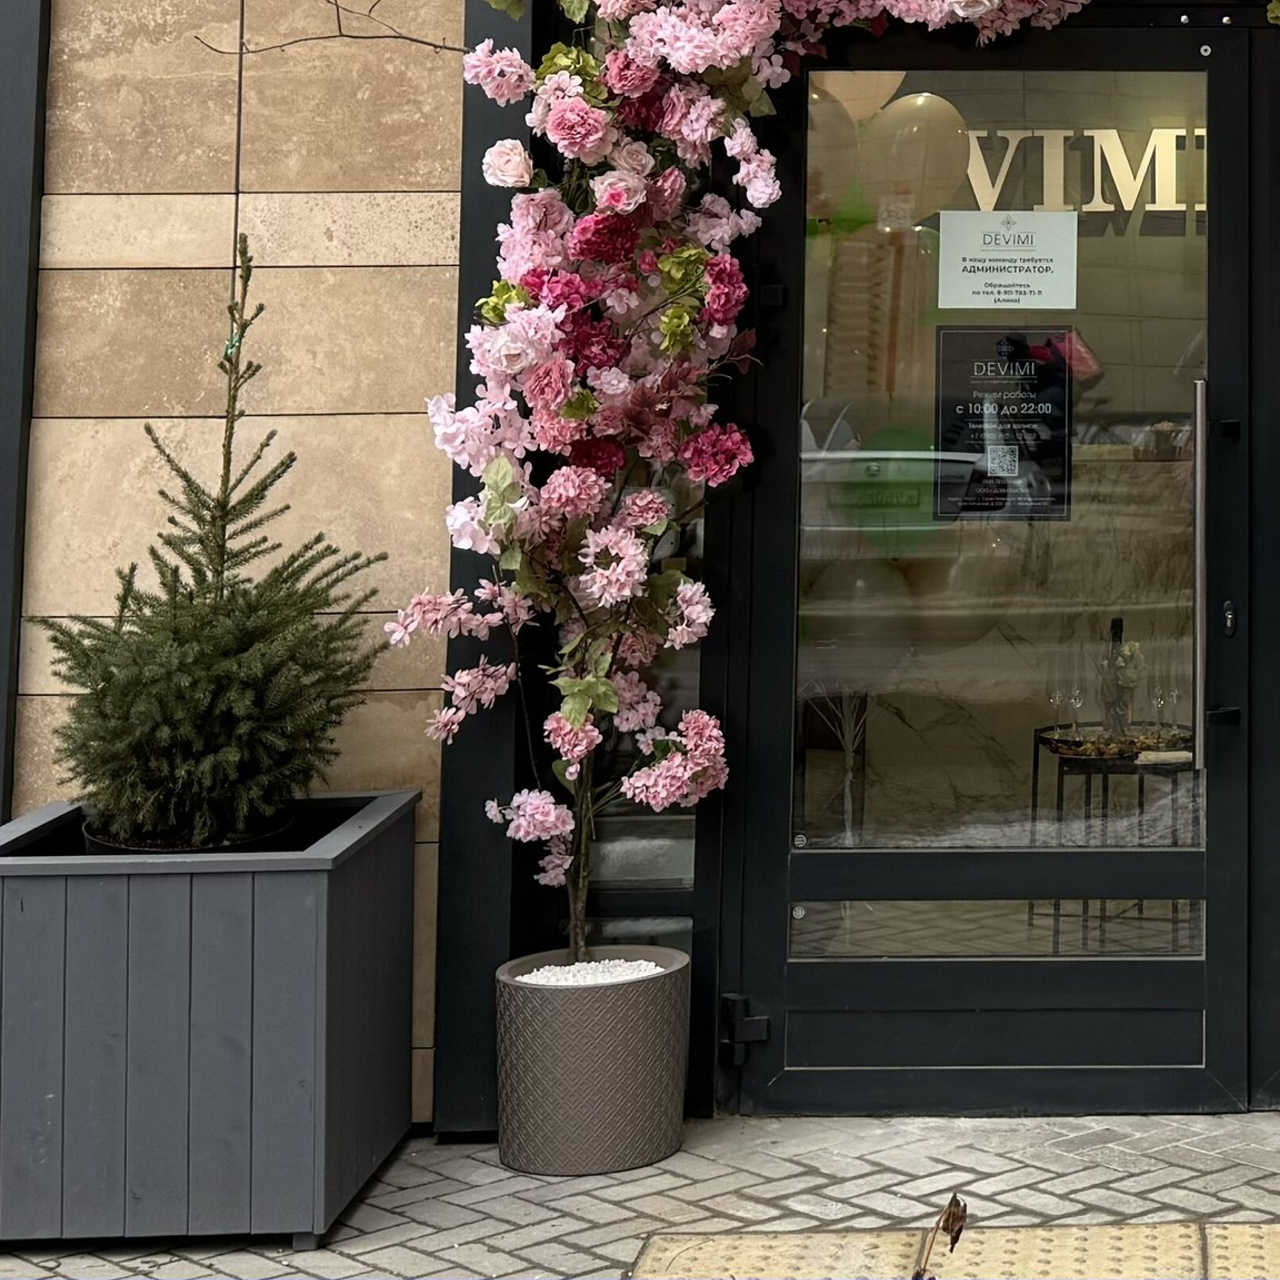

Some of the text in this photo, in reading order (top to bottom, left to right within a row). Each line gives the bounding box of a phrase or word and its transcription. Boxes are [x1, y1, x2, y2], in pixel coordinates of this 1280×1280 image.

[983, 233, 1034, 246] DEVIMI
[961, 265, 1055, 274] АДМИНИСТРАТОР.
[973, 362, 1035, 376] DEVIMI
[955, 403, 1052, 415] с 10:00 до 22:00
